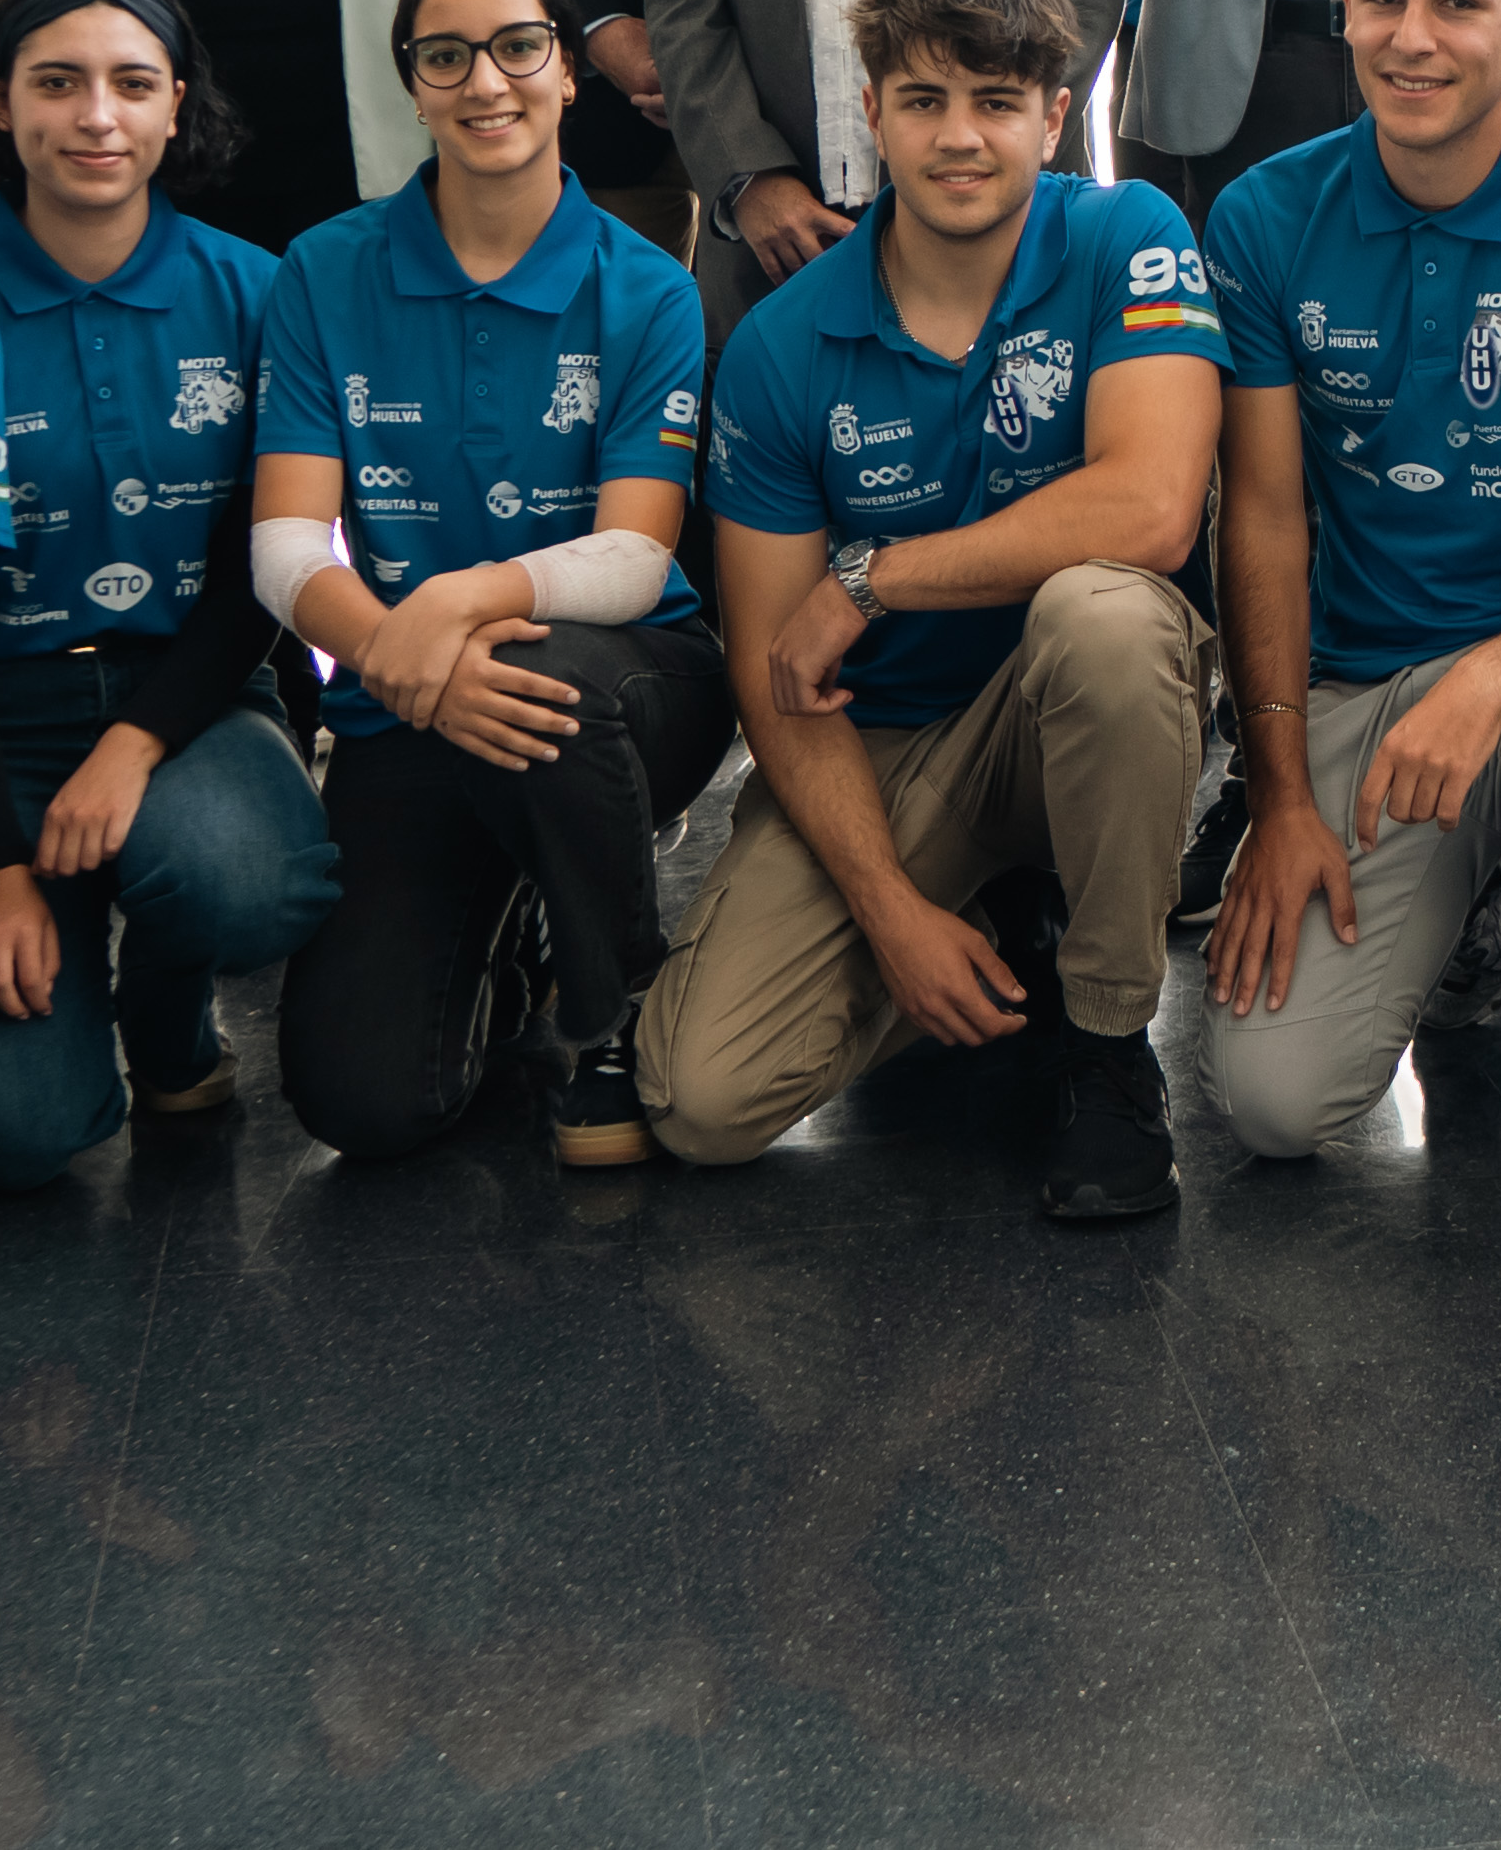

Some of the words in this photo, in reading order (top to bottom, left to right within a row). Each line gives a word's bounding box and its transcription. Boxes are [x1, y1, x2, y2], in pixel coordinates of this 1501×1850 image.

[1129, 246, 1208, 296] 93
[1328, 336, 1379, 349] HUELVA
[178, 356, 227, 371] MOTO
[1471, 328, 1491, 390] UHU
[663, 390, 698, 432] 9
[992, 376, 1023, 437] UHU
[370, 410, 423, 423] HUELVA
[864, 425, 914, 445] HUELVA
[1014, 467, 1042, 478] Puerto
[1044, 463, 1056, 473] de
[1394, 470, 1436, 486] GTO
[157, 483, 199, 495] Puerto
[200, 479, 214, 492] de
[532, 488, 570, 500] Puerto
[572, 486, 583, 497] de
[846, 487, 921, 507] UNIVERSITAS
[923, 480, 942, 494] XXI
[420, 500, 439, 513] XXI
[48, 510, 70, 523] XXI
[93, 574, 144, 597] GTO
